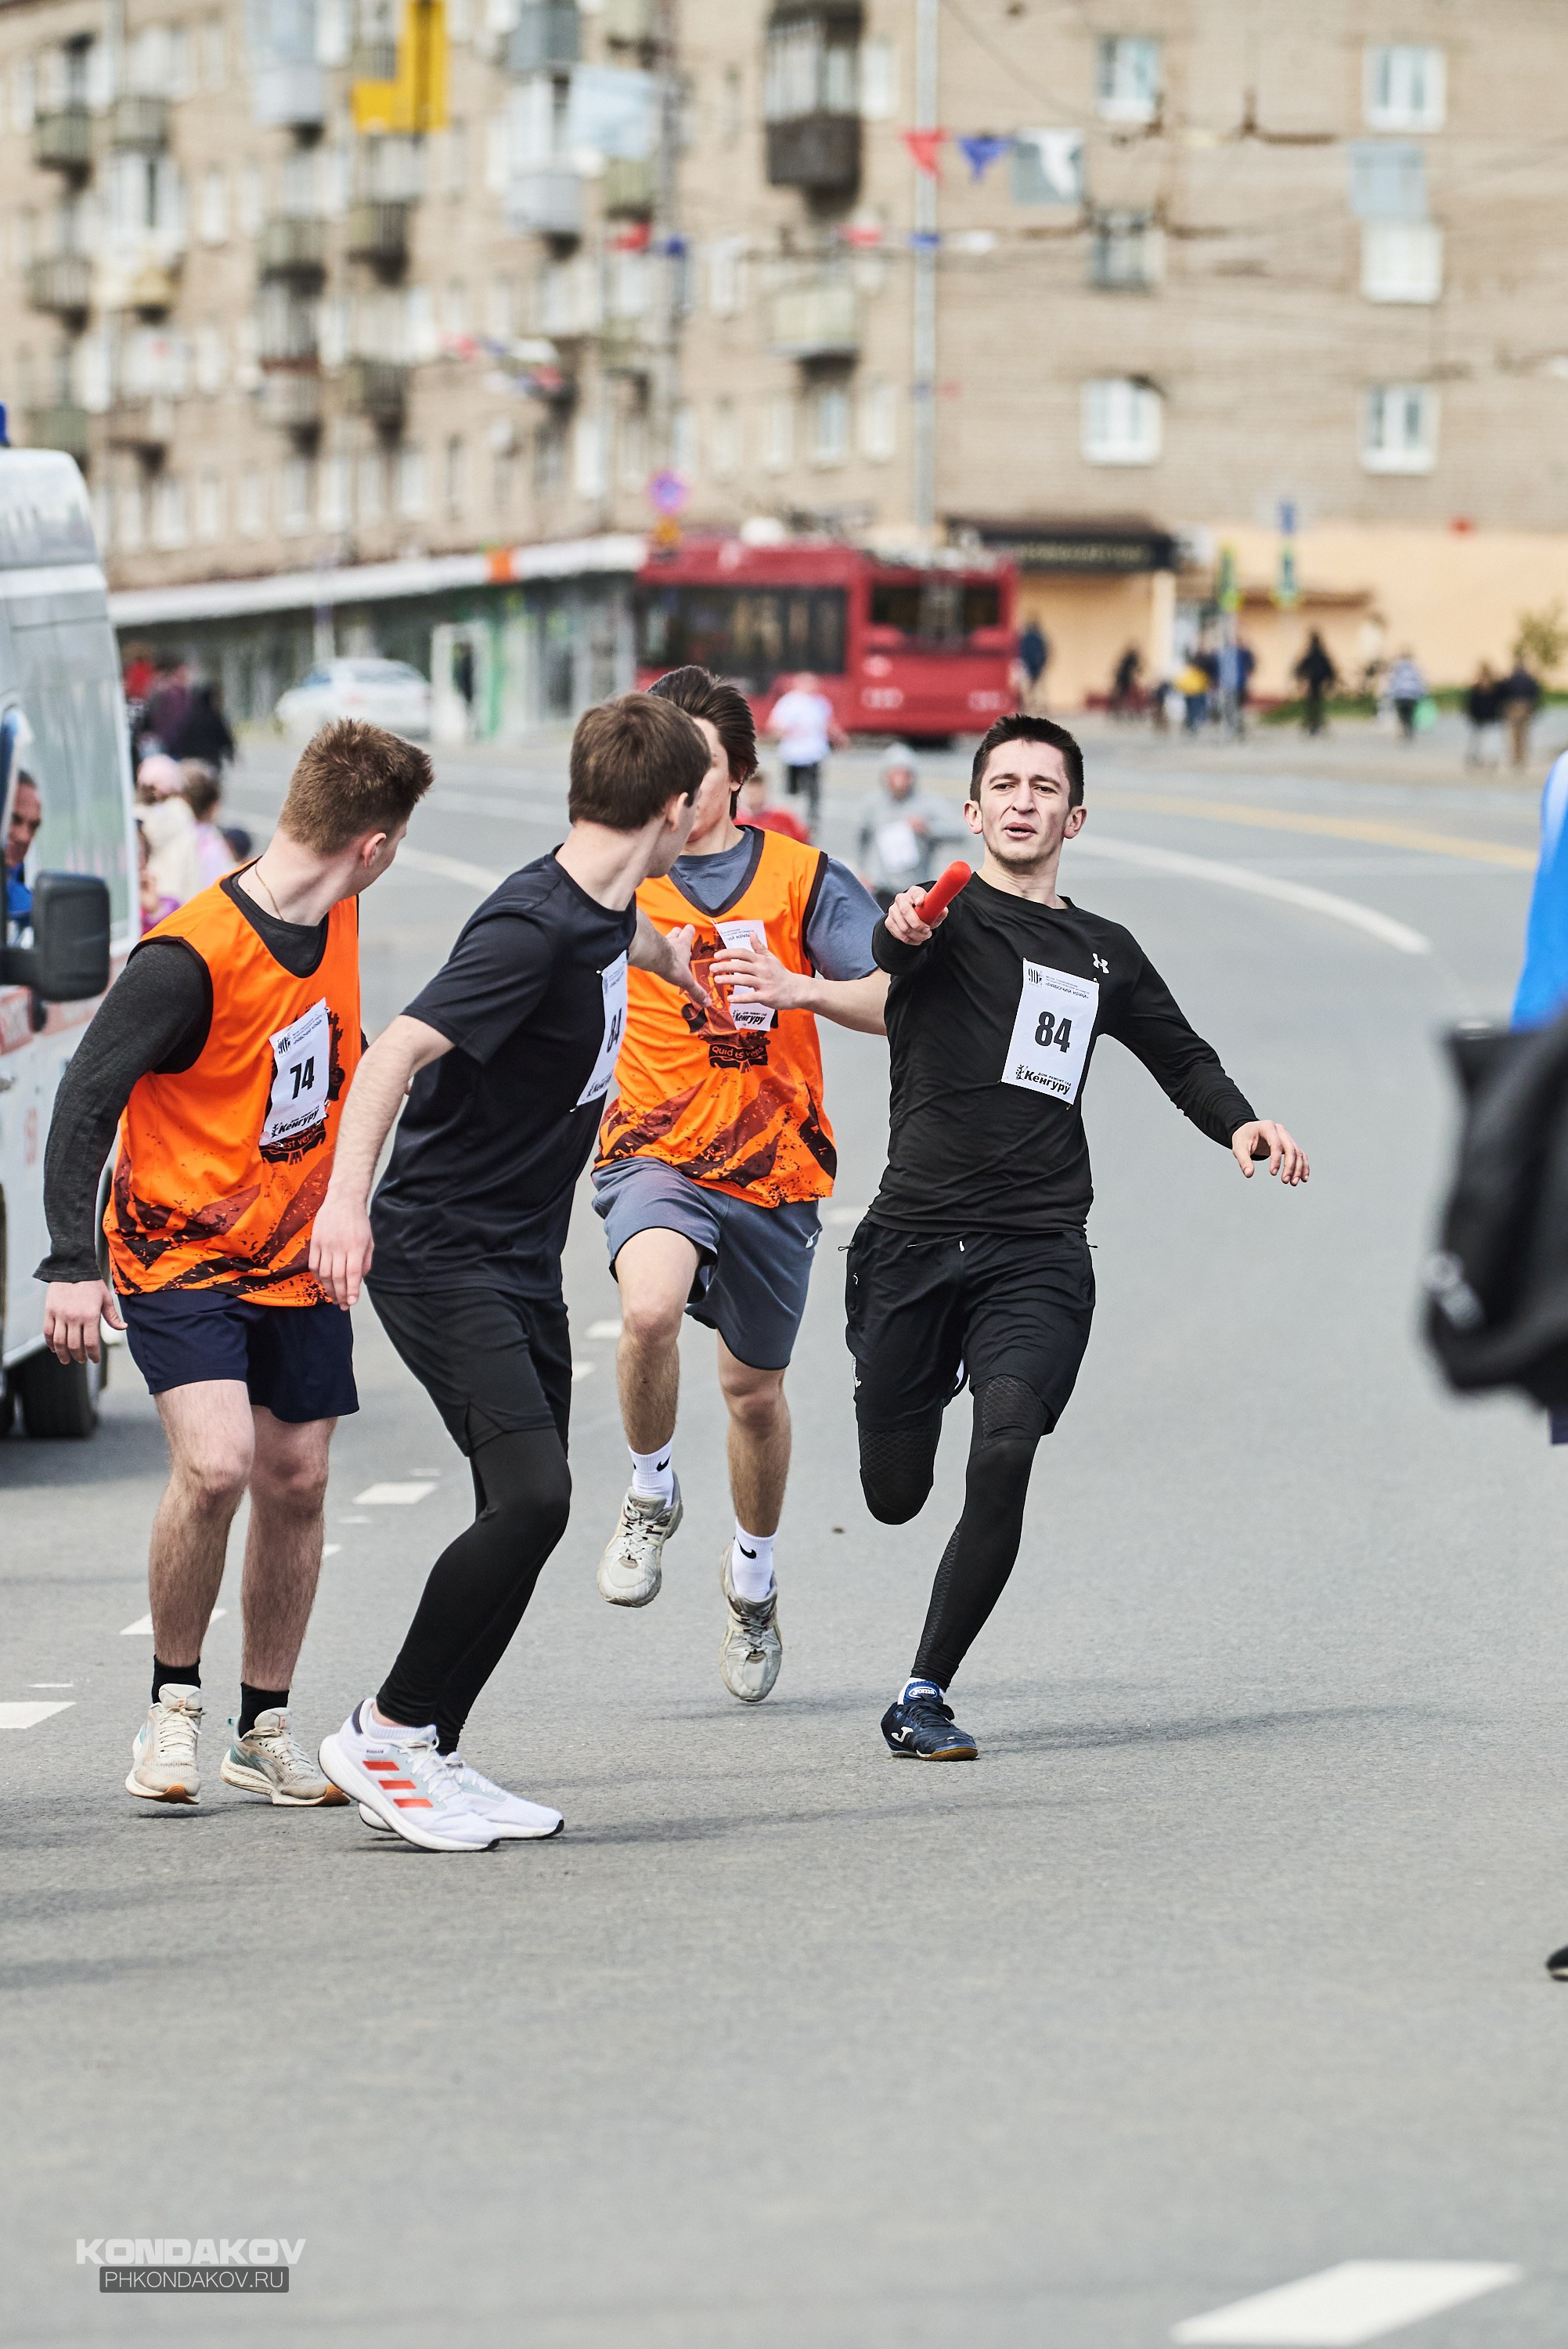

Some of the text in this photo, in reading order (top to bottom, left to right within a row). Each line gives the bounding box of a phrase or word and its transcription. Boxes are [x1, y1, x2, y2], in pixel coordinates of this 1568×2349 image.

[607, 1008, 622, 1053] 84
[734, 1012, 766, 1025] Кенгуру
[1035, 1011, 1072, 1053] 84
[712, 1045, 734, 1056] Quid
[290, 1056, 315, 1100] 74
[1024, 1070, 1071, 1095] Кенгуру
[278, 1108, 319, 1135] Кенгуру
